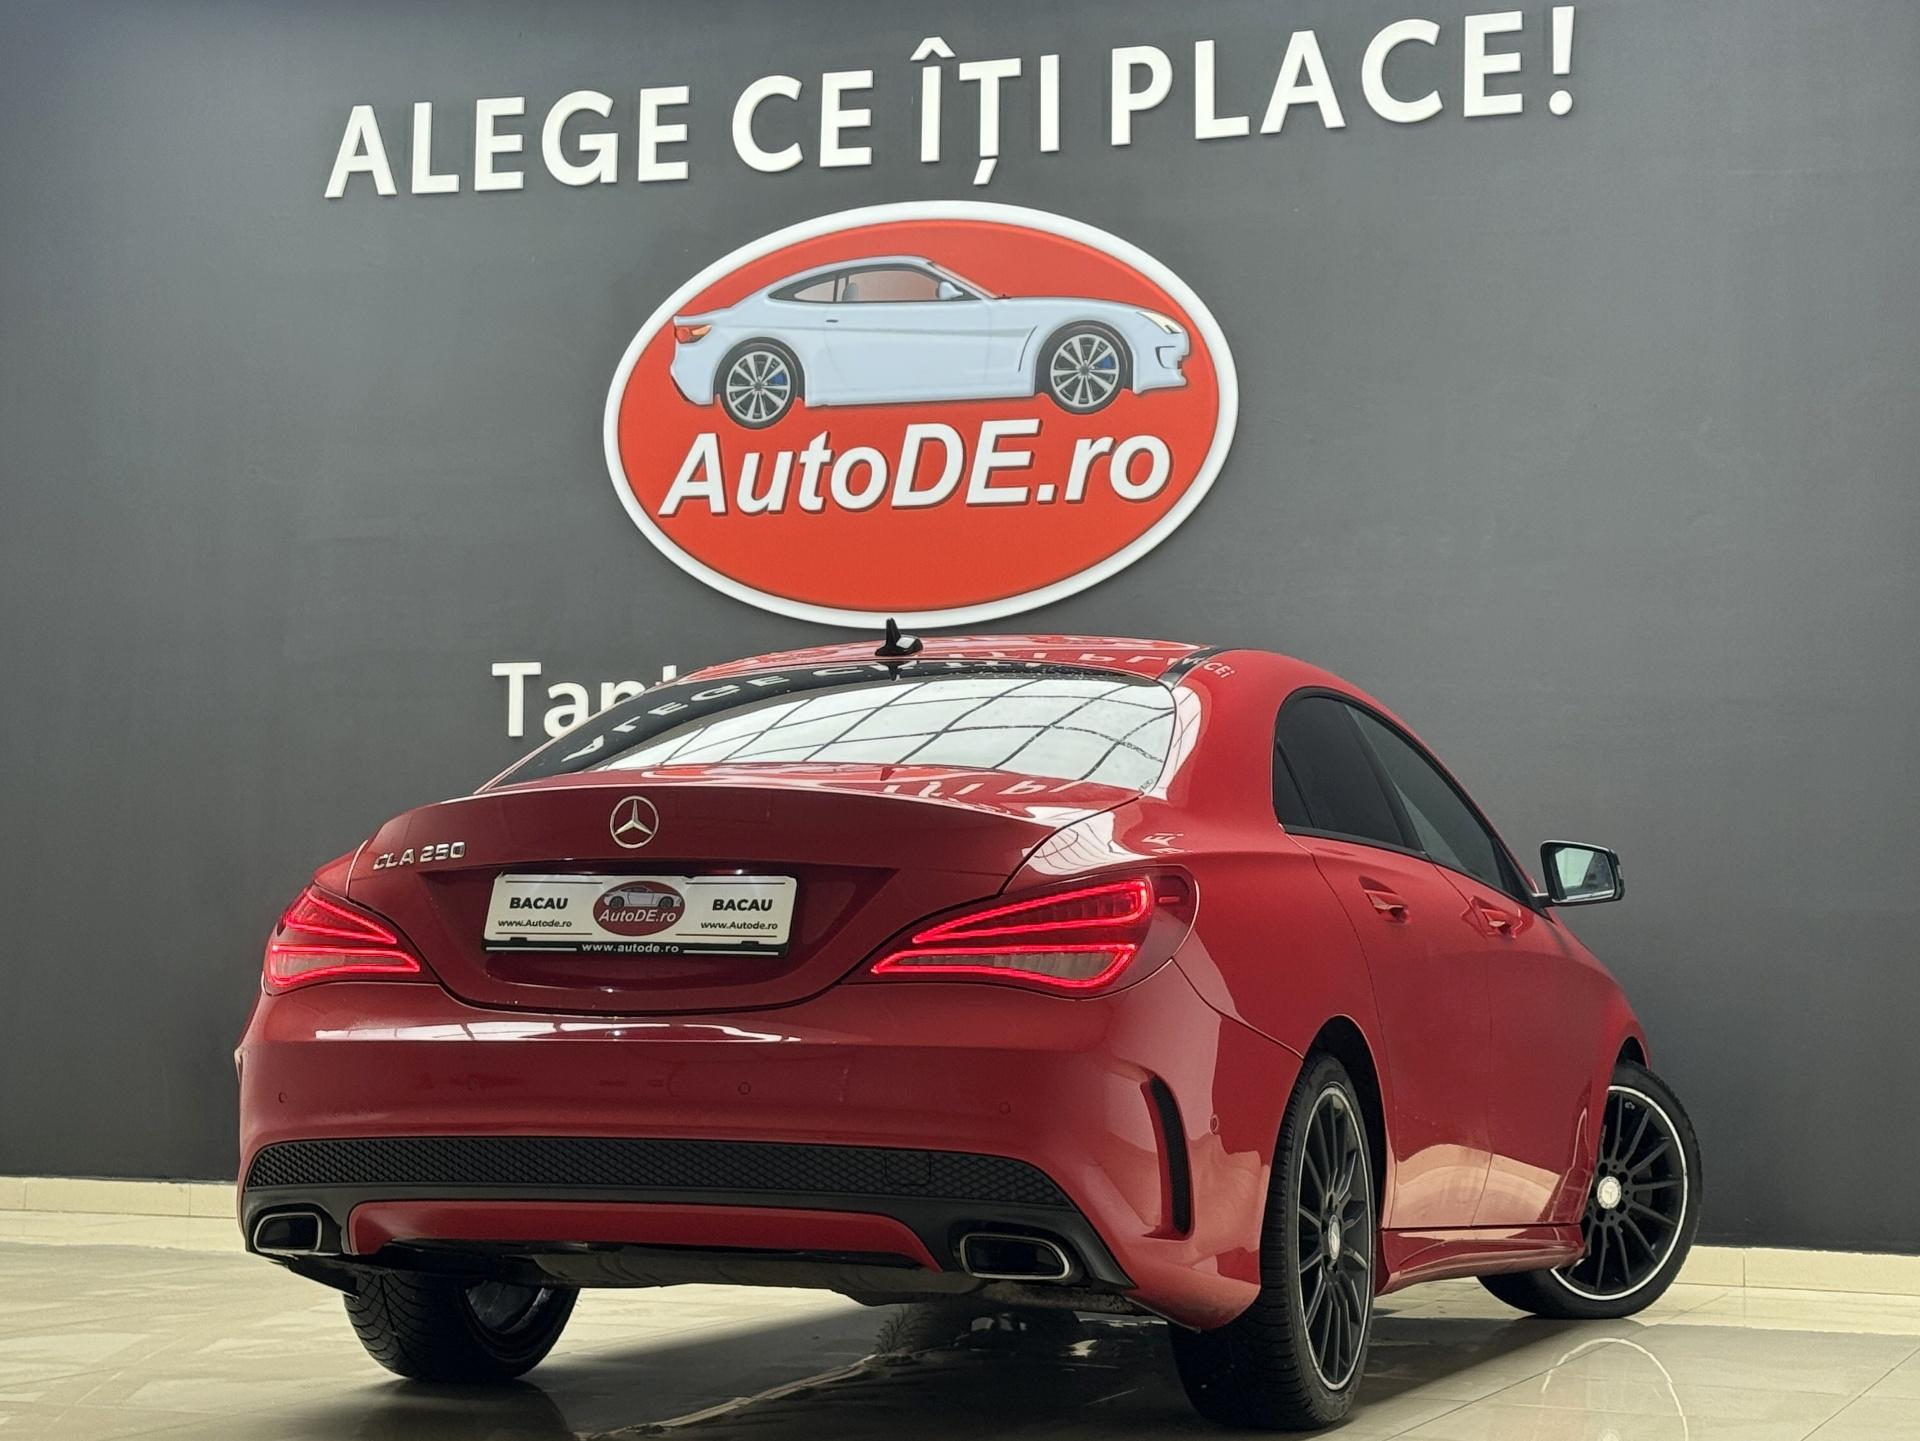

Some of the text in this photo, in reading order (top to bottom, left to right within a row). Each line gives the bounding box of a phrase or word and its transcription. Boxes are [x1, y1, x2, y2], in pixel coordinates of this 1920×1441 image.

[325, 86, 689, 198] ALEGE
[732, 70, 873, 173] CE
[1111, 6, 1575, 146] PLACE!
[658, 418, 1172, 516] AutoDE.ro
[373, 842, 465, 870] CLA 250
[509, 897, 568, 909] BACAU
[712, 899, 773, 911] BACAU
[599, 908, 676, 922] AutoDE.ro
[498, 919, 572, 928] www.Autode.ro
[700, 921, 778, 930] www.Autode.ro
[581, 943, 679, 953] www.autode.ro
